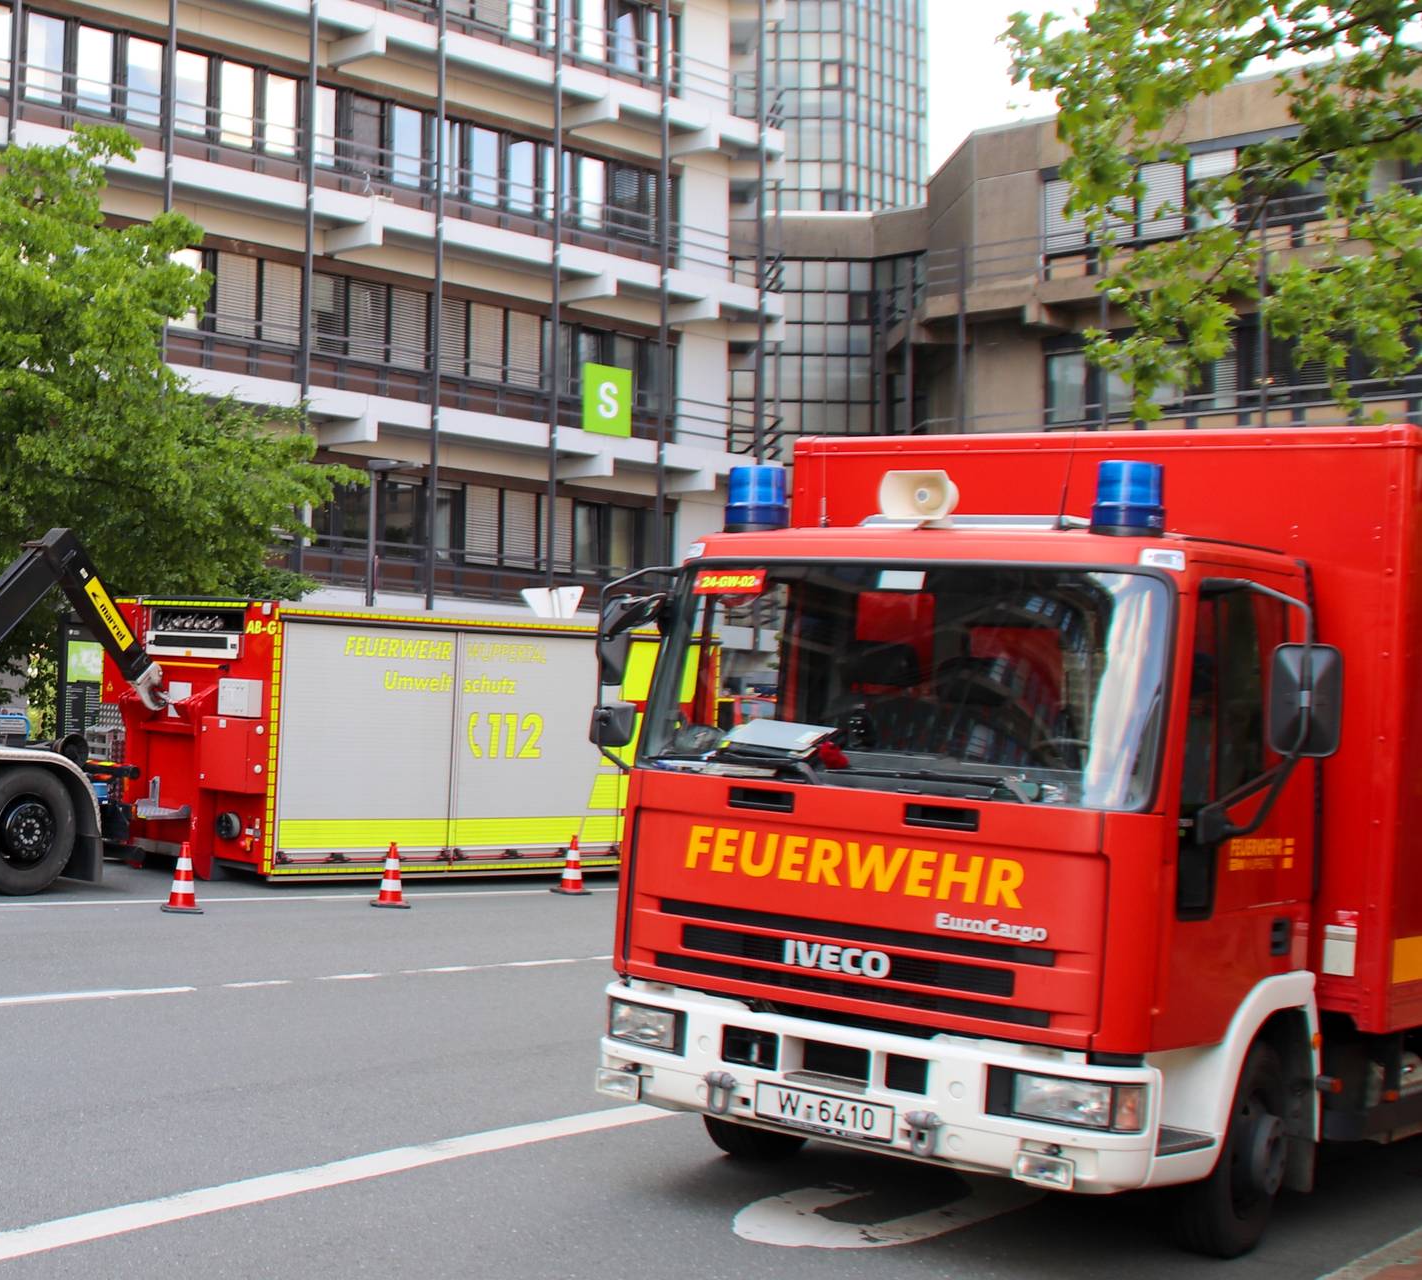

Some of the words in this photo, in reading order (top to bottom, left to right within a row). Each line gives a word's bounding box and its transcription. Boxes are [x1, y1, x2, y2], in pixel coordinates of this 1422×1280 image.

[598, 381, 619, 419] S
[700, 575, 756, 588] 24-GW-02
[99, 603, 127, 642] marrel
[245, 620, 277, 636] AB-G
[344, 635, 453, 661] FEUERWEHR
[465, 641, 547, 664] WUPPERTAL
[384, 670, 453, 692] Umwelt
[463, 674, 517, 695] schutz
[487, 712, 545, 759] 112
[1230, 838, 1283, 856] FEUERWEHR
[684, 825, 1025, 909] FEUERWEHR
[935, 912, 1048, 943] EuroCargo
[783, 938, 891, 979] IVECO
